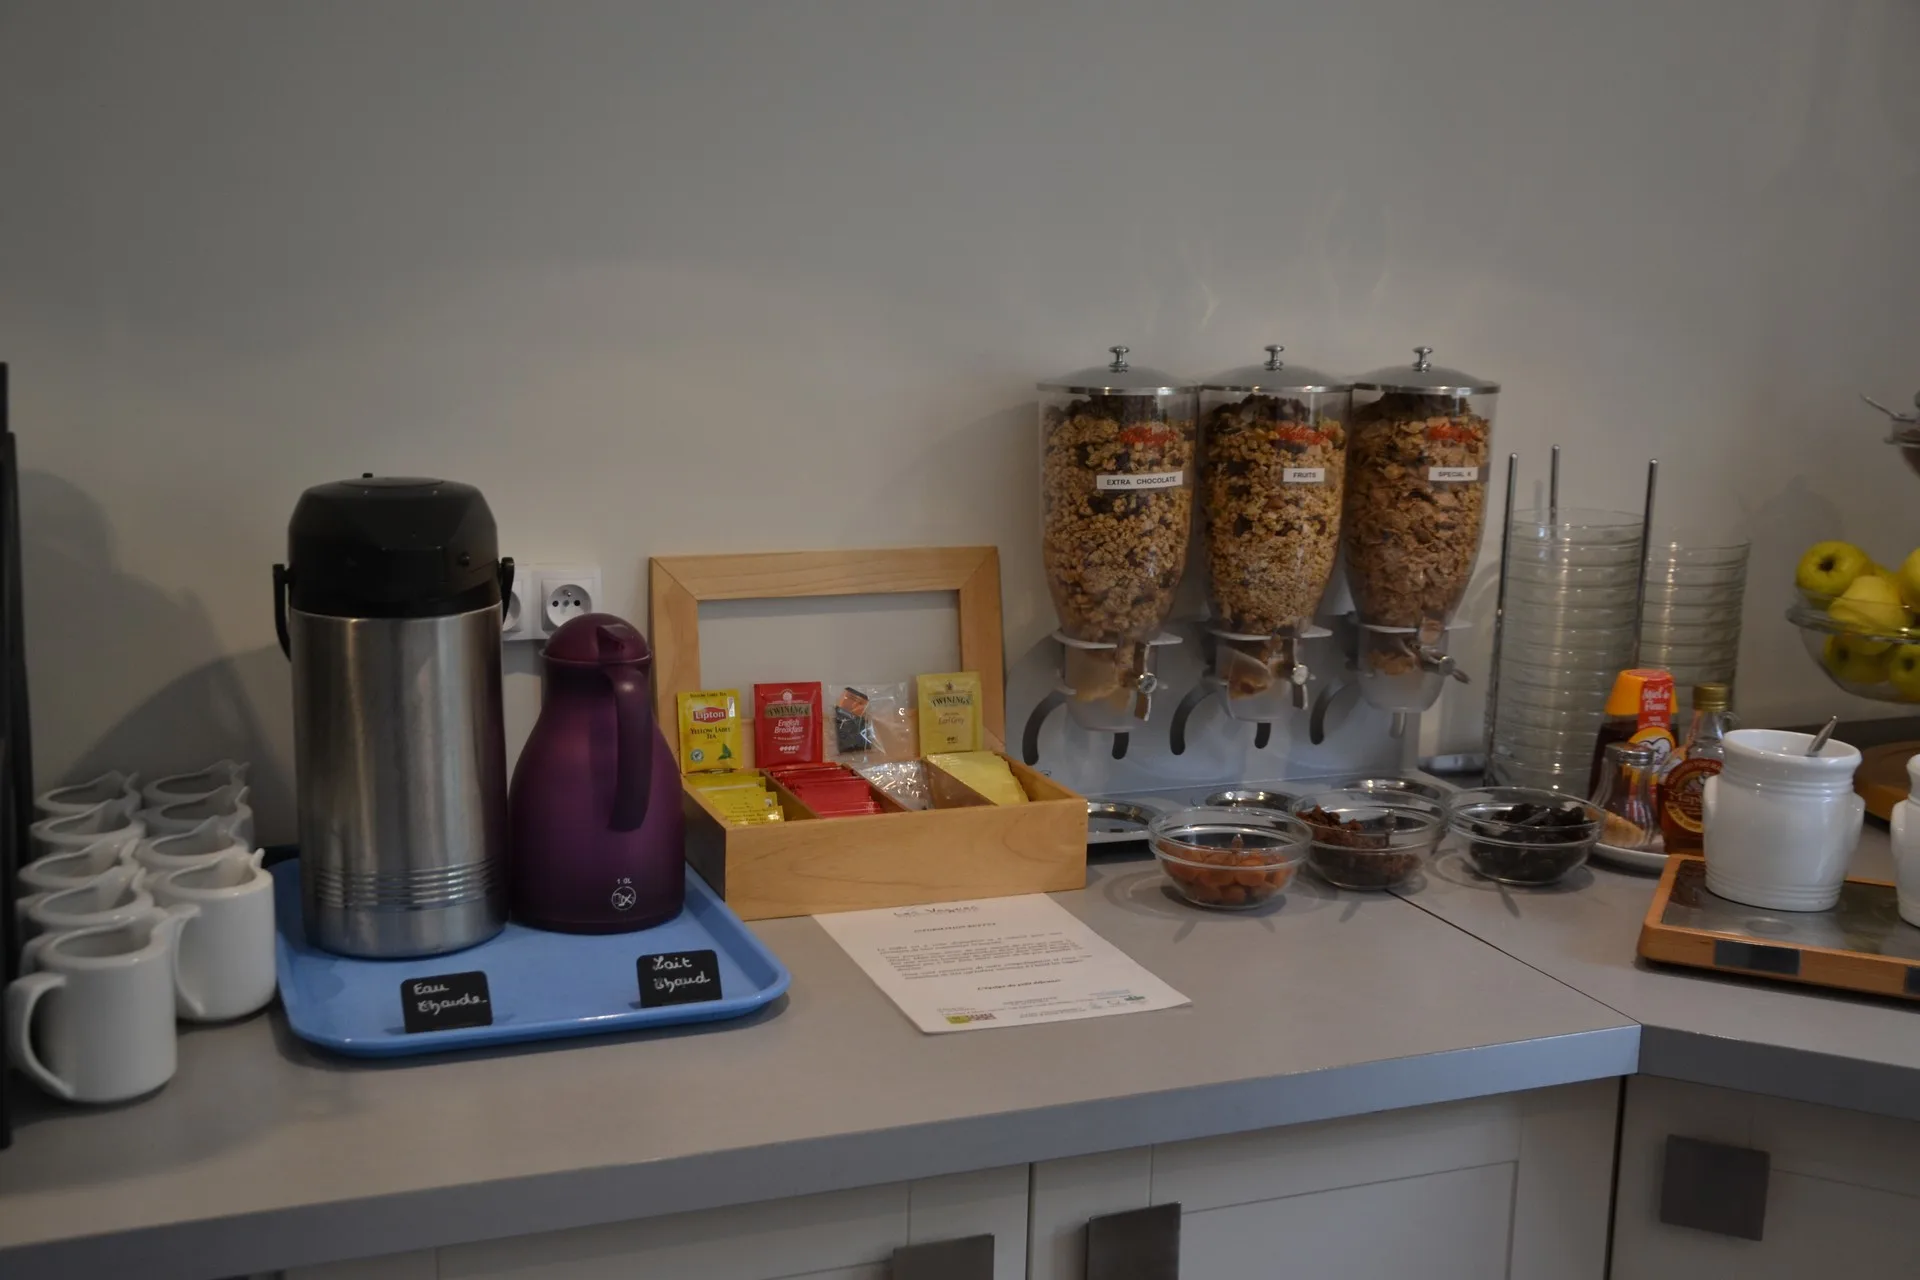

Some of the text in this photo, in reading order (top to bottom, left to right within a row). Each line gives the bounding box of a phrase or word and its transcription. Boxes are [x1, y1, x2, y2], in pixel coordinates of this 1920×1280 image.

[1293, 471, 1316, 479] FRUITS
[1136, 476, 1176, 485] CHOCOLATE
[930, 695, 970, 707] TWININGS
[695, 711, 725, 720] Lipton
[767, 704, 811, 717] TWININGS
[777, 719, 800, 729] English
[774, 726, 804, 735] Breakfast
[652, 955, 693, 972] Lait
[413, 982, 450, 996] Eau
